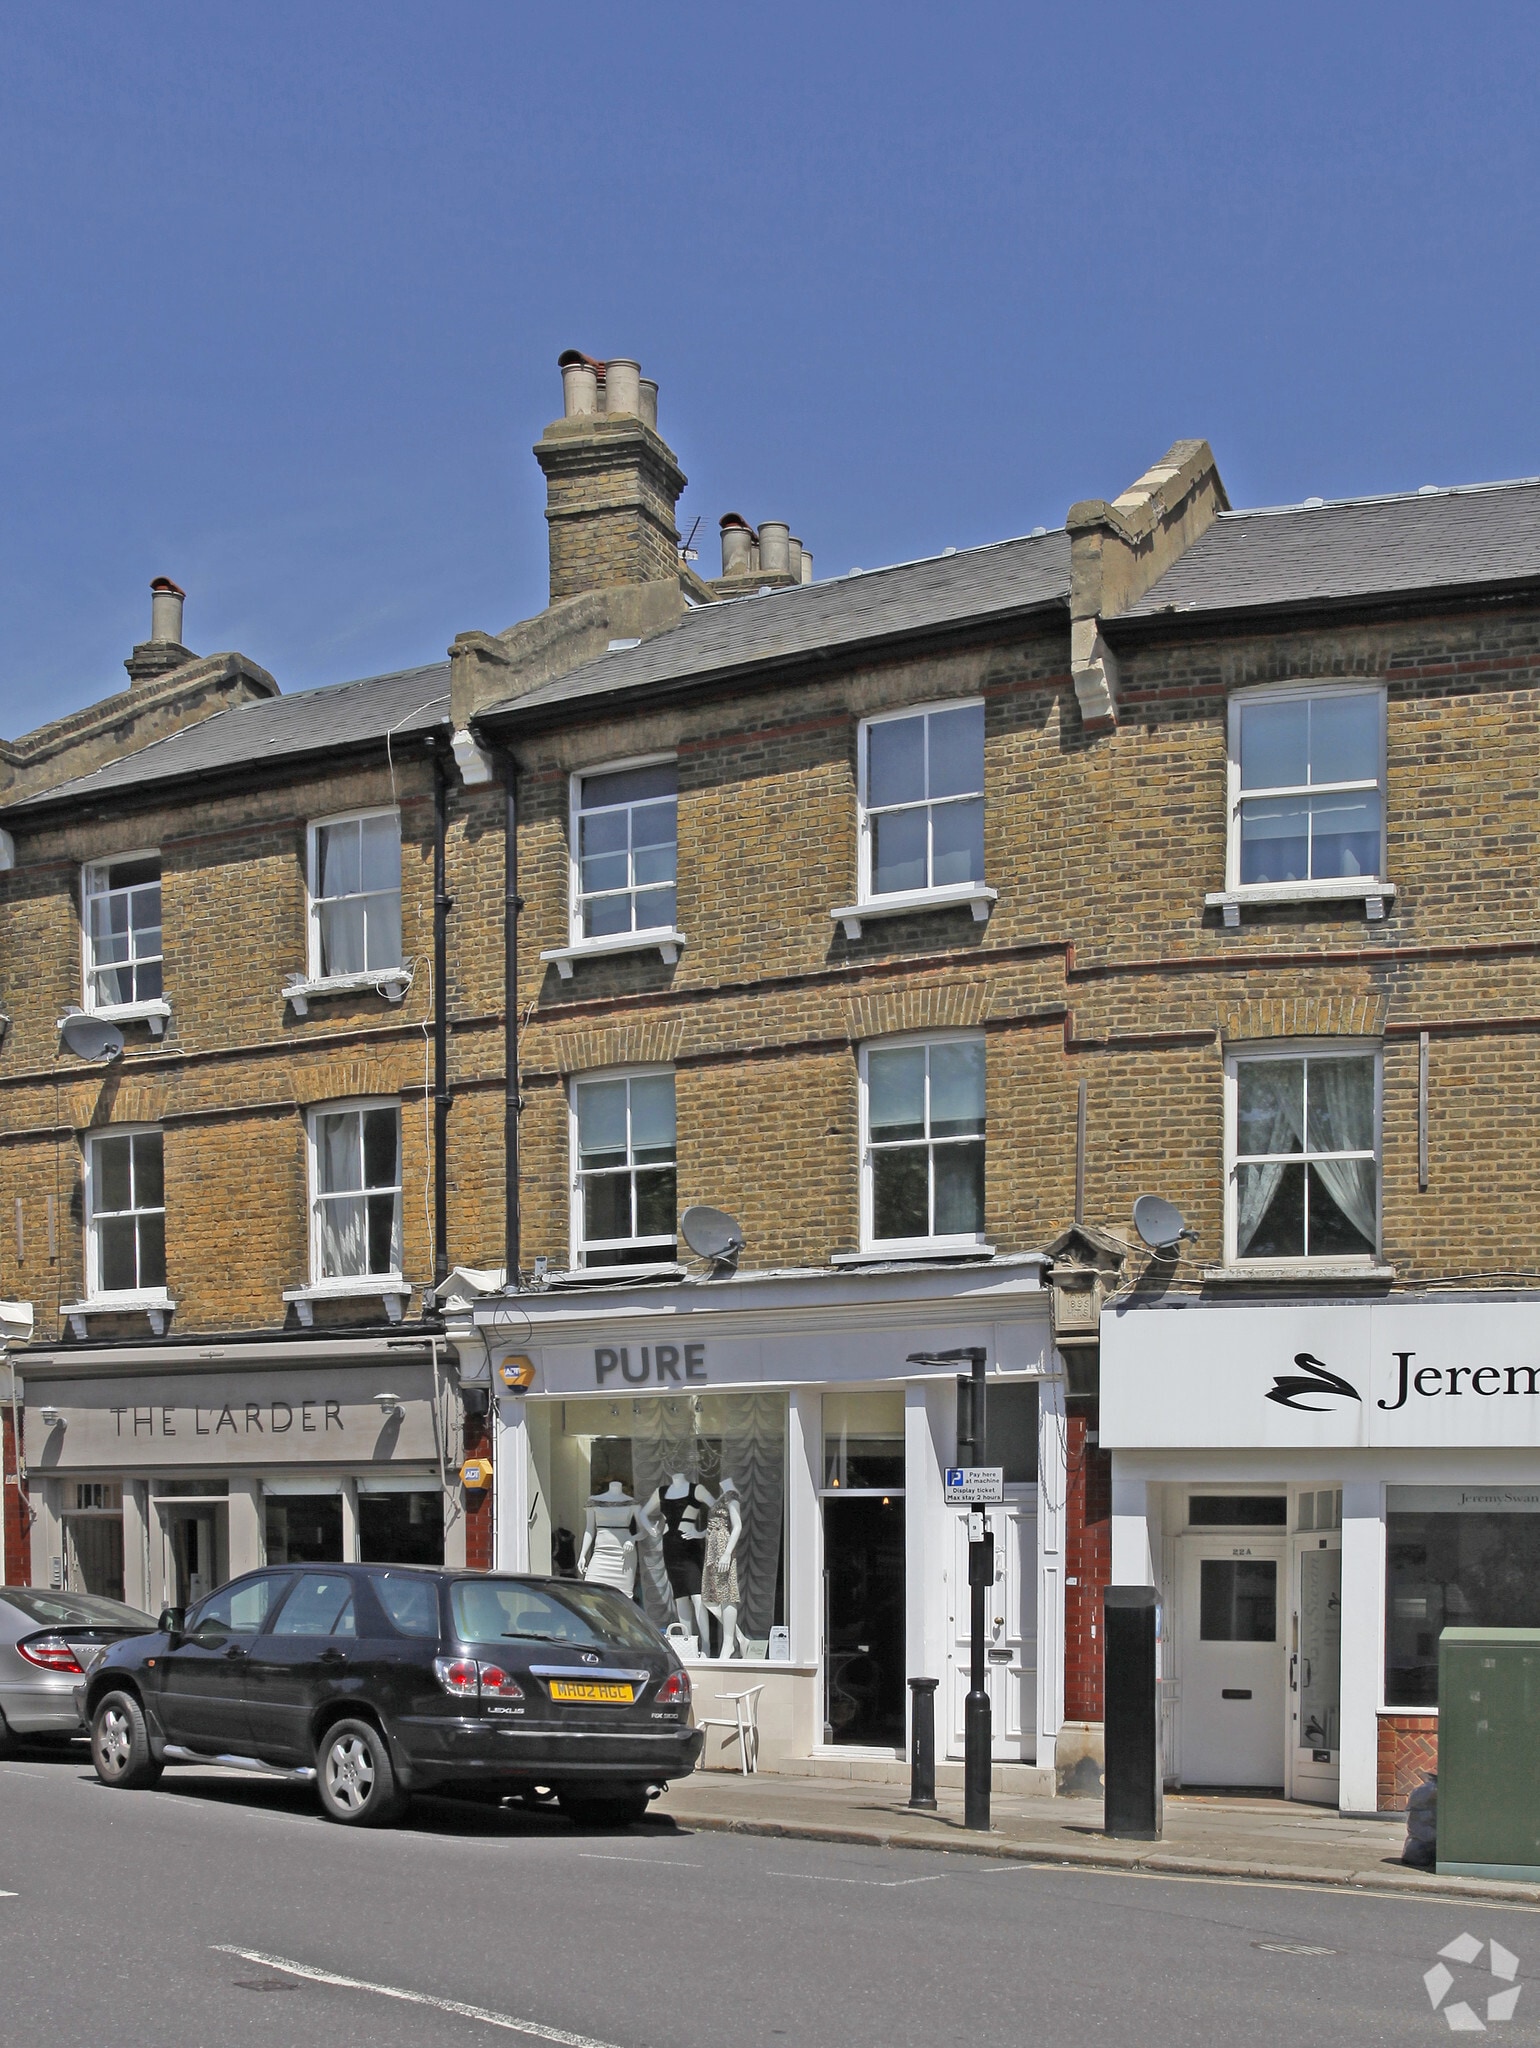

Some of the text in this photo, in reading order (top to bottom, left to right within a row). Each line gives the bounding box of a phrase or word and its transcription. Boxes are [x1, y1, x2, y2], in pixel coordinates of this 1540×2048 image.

[594, 1344, 707, 1384] PURE
[504, 1366, 520, 1376] ADT
[1377, 1352, 1540, 1410] Jerem
[110, 1400, 344, 1436] THE LARDER
[465, 1470, 479, 1479] ADT
[1232, 1548, 1251, 1556] 22A
[487, 1706, 525, 1714] LEXUS
